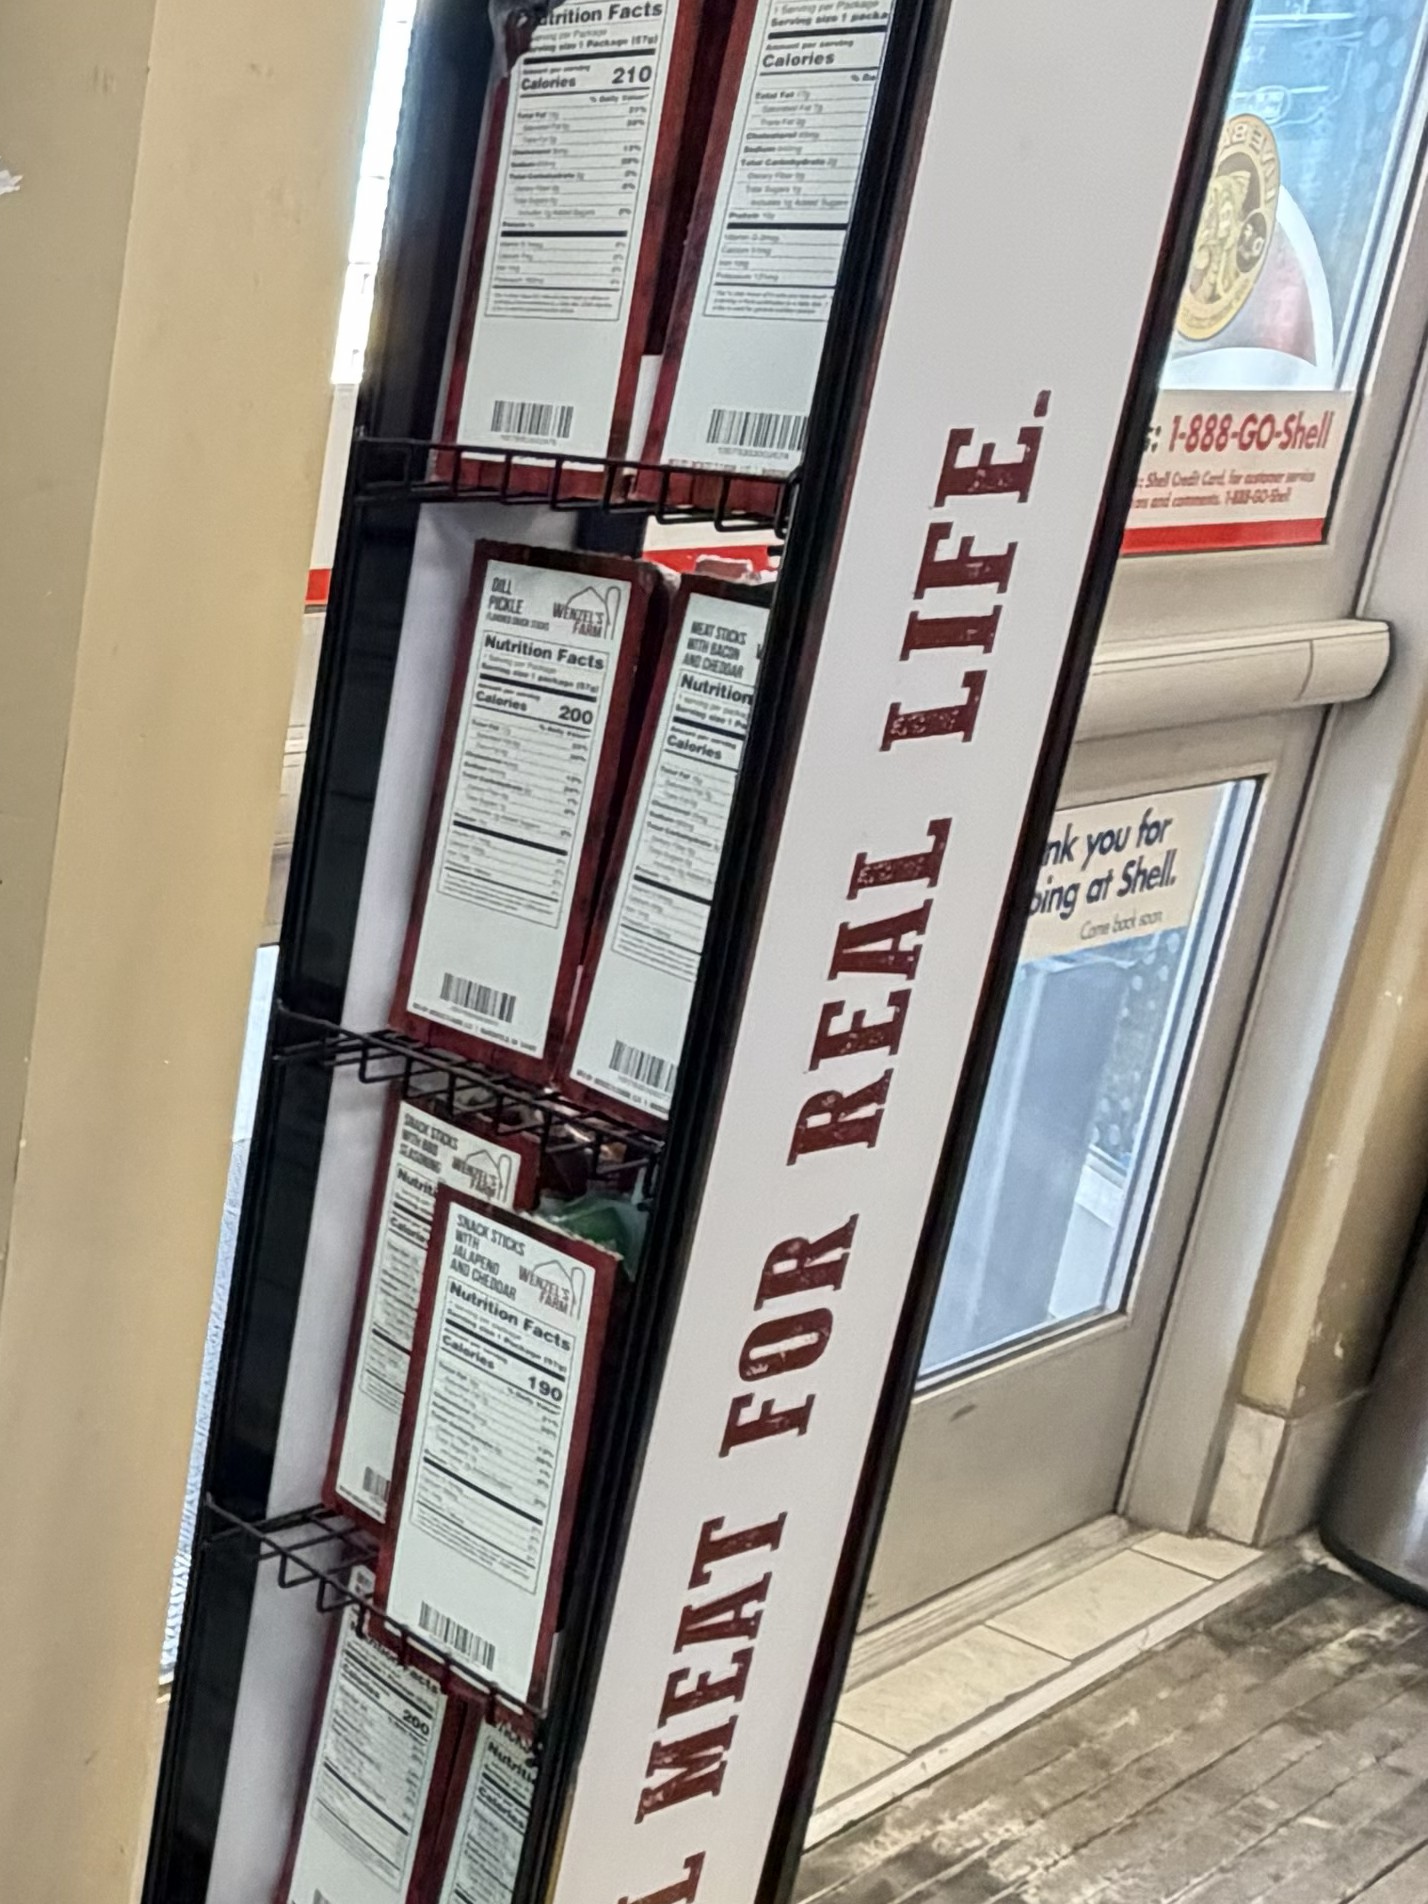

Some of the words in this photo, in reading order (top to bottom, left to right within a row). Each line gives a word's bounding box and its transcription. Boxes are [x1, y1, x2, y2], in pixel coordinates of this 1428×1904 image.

[608, 1, 663, 20] Facts
[612, 66, 652, 84] 210
[762, 52, 835, 68] Calories
[1169, 411, 1335, 453] 1-888-GO-Shell
[880, 389, 1052, 753] LIFE.
[484, 636, 552, 660] Nutrition
[557, 650, 604, 670] Facts
[476, 692, 527, 712] Calories
[558, 705, 593, 725] 200
[666, 735, 722, 760] Calories
[1081, 826, 1131, 871] you
[1136, 807, 1173, 848] for
[1086, 869, 1113, 904] at
[1117, 849, 1177, 897] Shell.
[787, 818, 952, 1167] REAL
[450, 1282, 518, 1326] Nutrition
[523, 1316, 571, 1351] Facts
[718, 1212, 863, 1459] FOR
[528, 1376, 563, 1402] 190
[634, 1510, 789, 1824] MEAT
